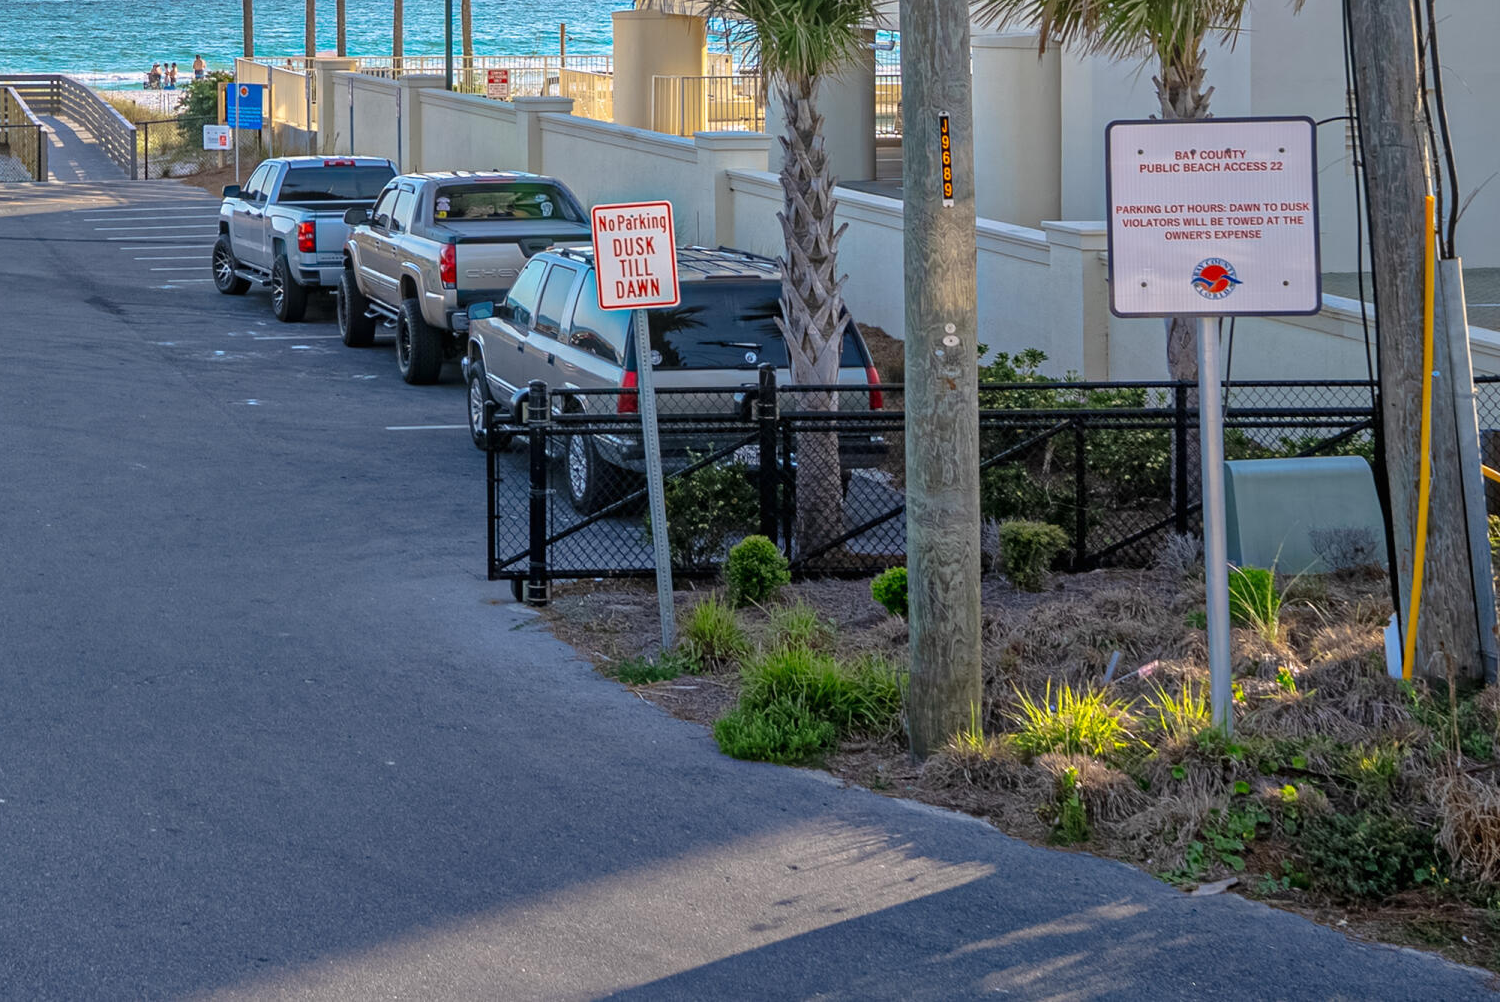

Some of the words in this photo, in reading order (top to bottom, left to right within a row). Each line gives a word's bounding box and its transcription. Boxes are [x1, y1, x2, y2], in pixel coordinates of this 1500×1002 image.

[941, 119, 953, 197] J9689
[1175, 151, 1196, 160] BAY
[1200, 150, 1246, 159] COUNTY
[1139, 164, 1180, 173] PUBLIC
[1183, 163, 1220, 172] BEACH
[1224, 162, 1267, 172] ACCESS
[1270, 161, 1283, 171] 22
[1116, 205, 1161, 214] PARKING
[1165, 205, 1184, 214] LOT
[1187, 204, 1226, 213] HOURS:
[1230, 203, 1261, 212] DAWN
[1263, 203, 1278, 212] TO
[1280, 202, 1310, 211] DUSK
[598, 215, 615, 232] No
[617, 213, 667, 233] Parking
[1122, 218, 1180, 227] VIOLATORS
[1183, 217, 1207, 226] WILL
[1210, 217, 1224, 226] BE
[1227, 216, 1263, 225] TOWED
[1267, 216, 1280, 225] AT
[1283, 215, 1304, 224] THE
[1165, 230, 1211, 240] OWNER'S
[1215, 229, 1262, 239] EXPENSE
[613, 237, 655, 257] DUSK
[619, 257, 653, 278] TILL
[616, 278, 660, 299] DAWN
